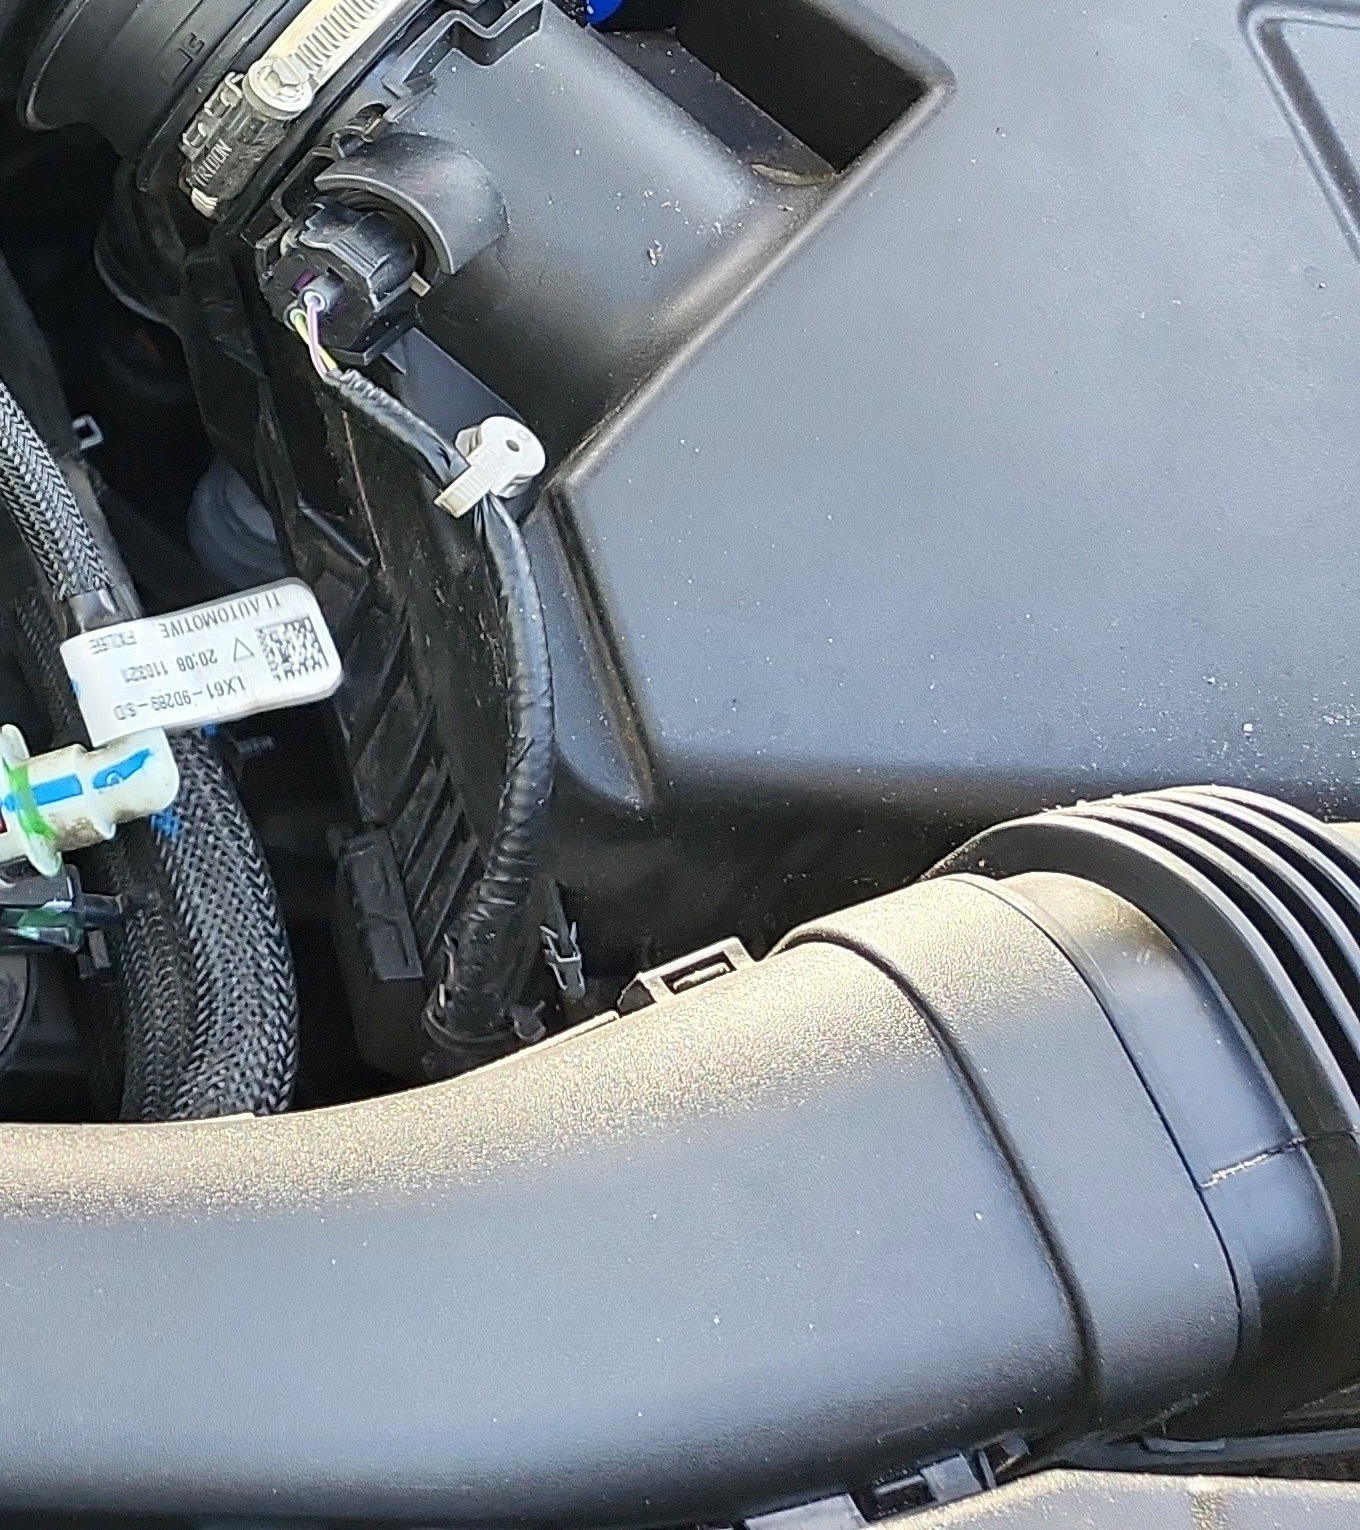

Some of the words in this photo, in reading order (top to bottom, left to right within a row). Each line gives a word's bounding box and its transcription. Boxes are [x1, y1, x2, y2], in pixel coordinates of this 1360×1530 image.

[193, 138, 233, 188] TRIDON
[160, 601, 262, 639] AUTOMOTIVE
[176, 648, 218, 670] 20:08
